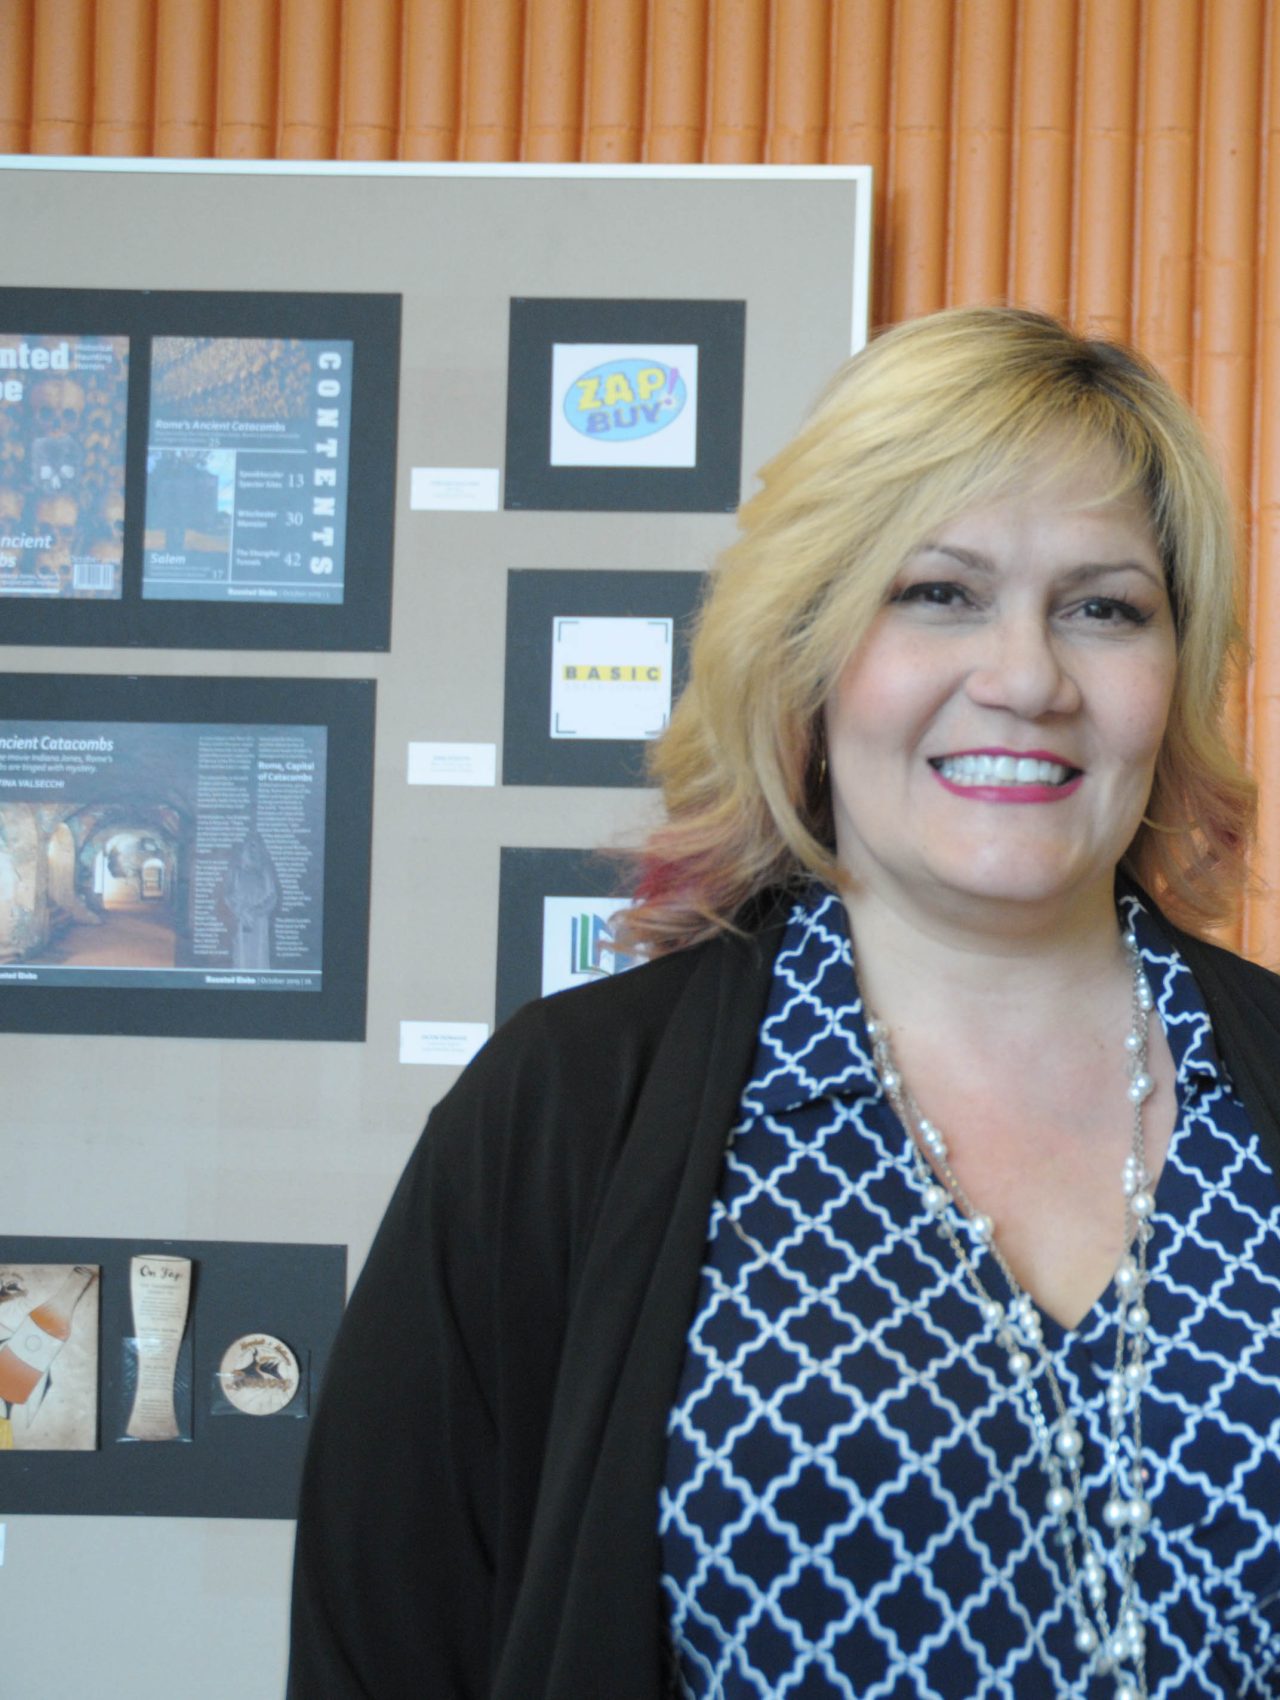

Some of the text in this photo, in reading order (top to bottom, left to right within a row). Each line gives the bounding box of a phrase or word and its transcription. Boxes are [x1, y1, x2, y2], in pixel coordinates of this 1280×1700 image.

[0, 380, 23, 402] e
[585, 402, 663, 434] BUY
[192, 420, 230, 431] Ancient
[232, 421, 286, 432] Catacombs
[310, 352, 342, 575] CONTENTS
[288, 473, 305, 488] 13
[285, 511, 304, 526] 30
[151, 552, 186, 565] Salem
[284, 552, 302, 567] 42
[565, 666, 660, 680] BASIC
[40, 735, 114, 752] Catacombs
